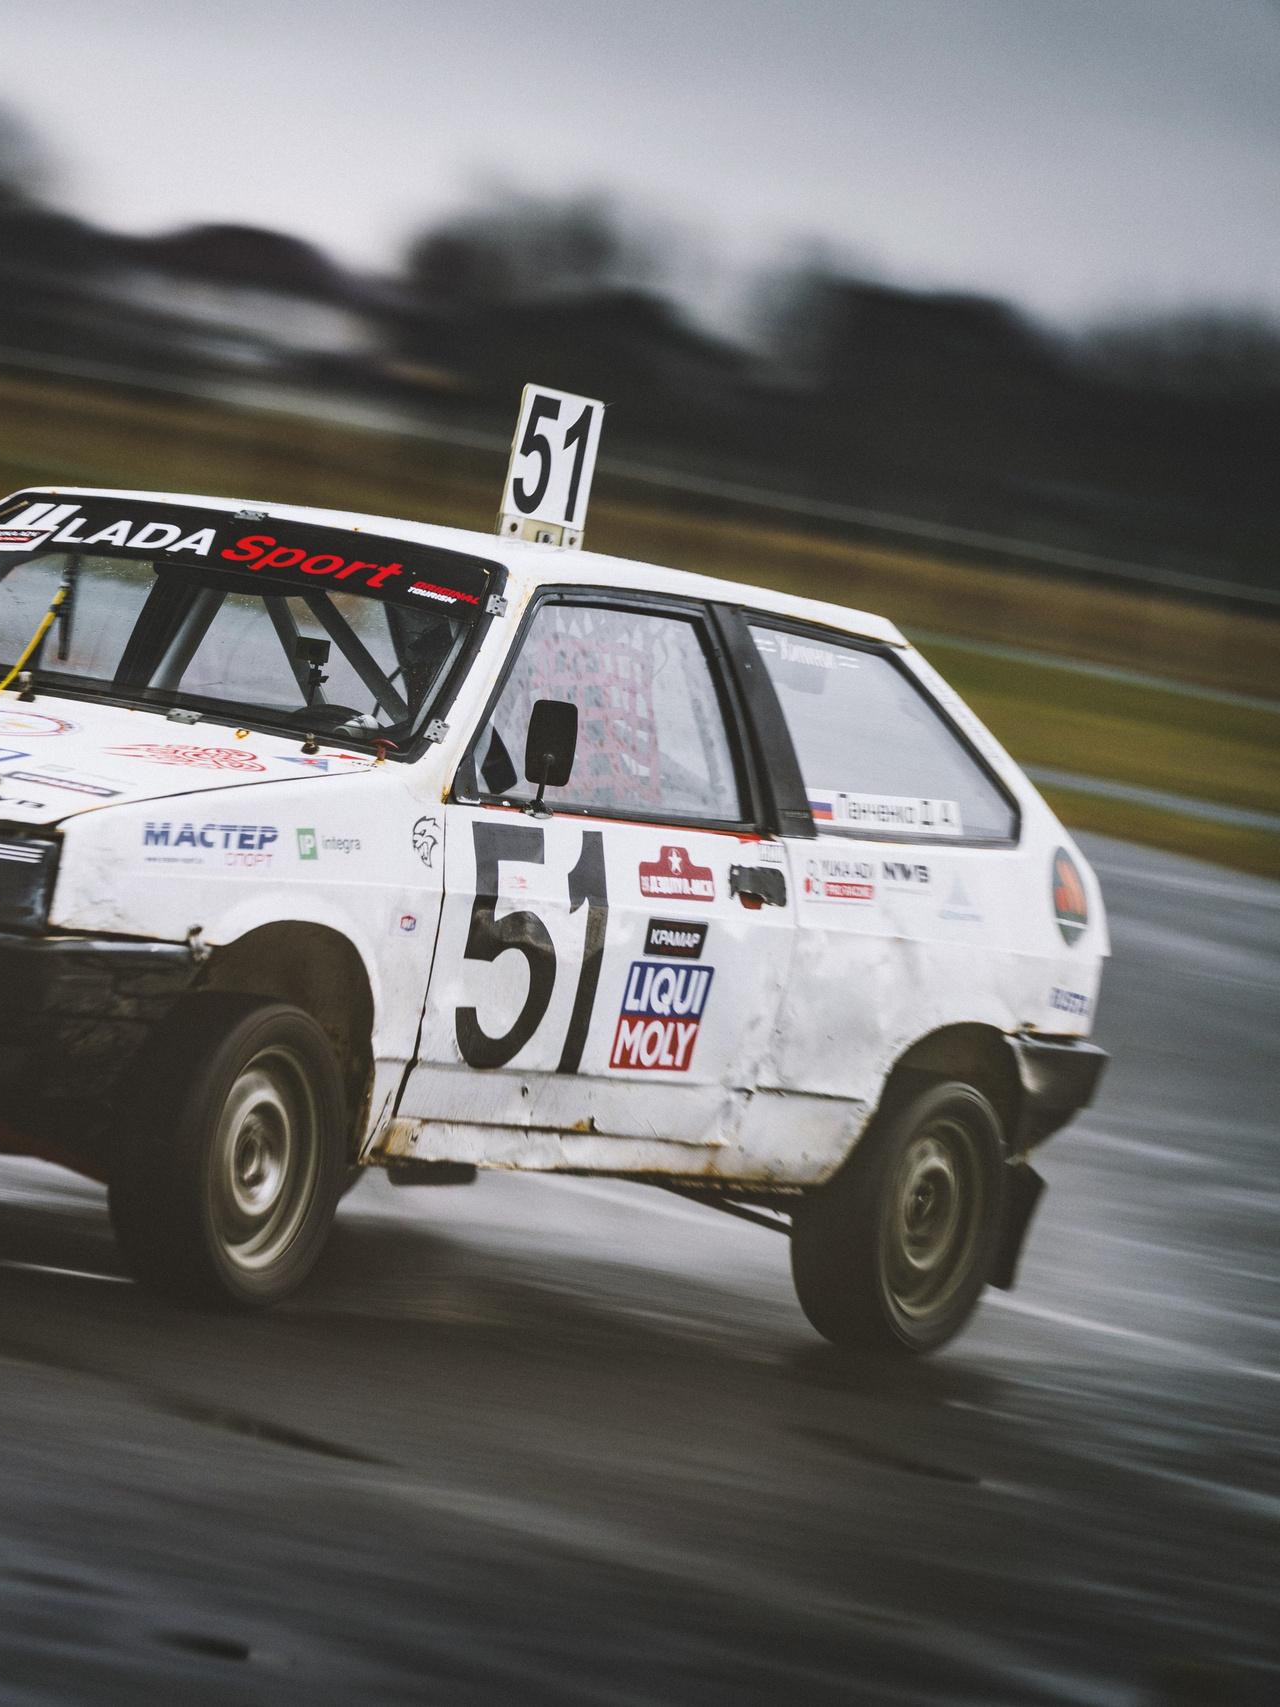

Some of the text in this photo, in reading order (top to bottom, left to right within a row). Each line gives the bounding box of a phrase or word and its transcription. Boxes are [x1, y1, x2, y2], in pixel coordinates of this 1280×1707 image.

[513, 394, 594, 523] 51
[51, 517, 404, 588] LADA Sport
[407, 586, 458, 604] TOURISM
[413, 581, 480, 605] ORIGINAL
[144, 822, 278, 850] МАСТЕР
[322, 835, 361, 853] integra
[455, 821, 609, 1075] 51
[625, 965, 710, 1016] LIQUI
[613, 1019, 698, 1067] MOLY
